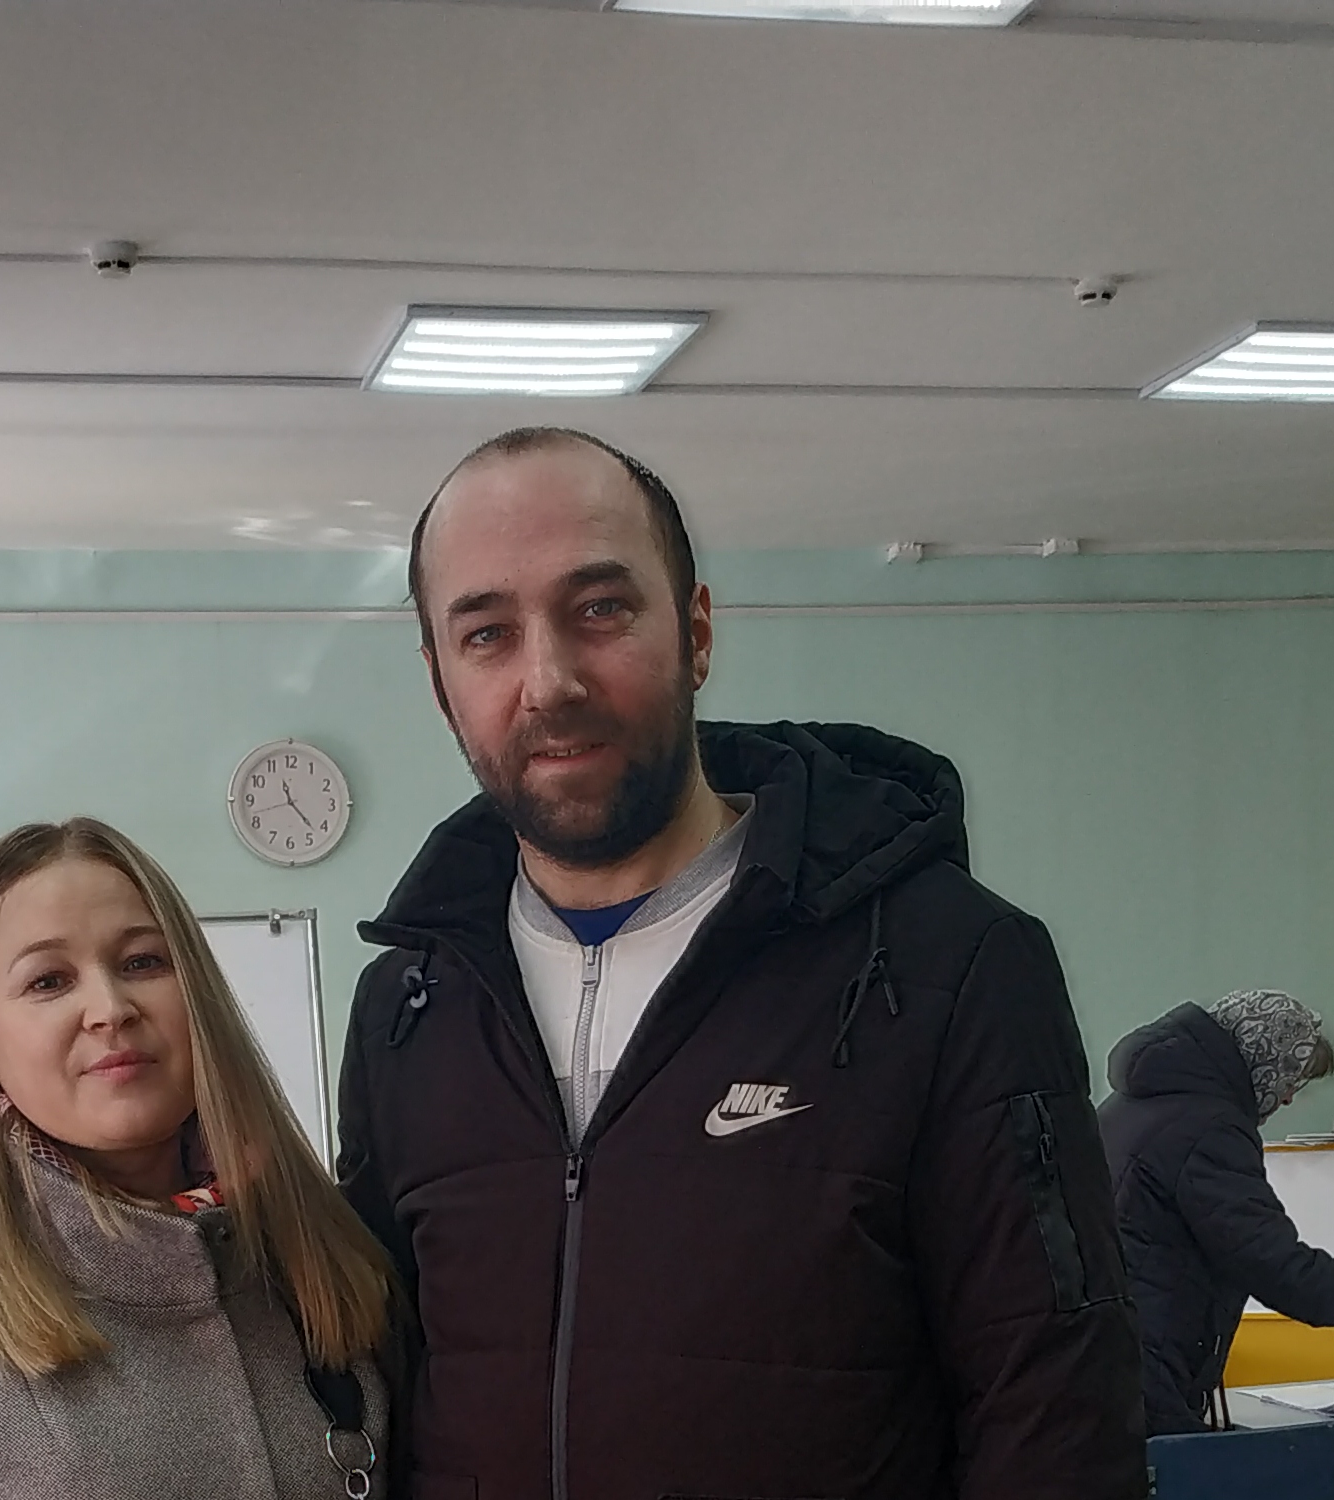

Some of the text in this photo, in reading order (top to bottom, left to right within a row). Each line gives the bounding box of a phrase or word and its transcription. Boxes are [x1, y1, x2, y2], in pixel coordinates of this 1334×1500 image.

[267, 759, 276, 773] 11
[284, 755, 298, 769] 12
[309, 762, 314, 775] 1
[252, 774, 265, 788] 10
[322, 779, 331, 792] 2
[245, 794, 255, 807] 9
[328, 798, 336, 812] 3
[251, 816, 261, 830] 8
[320, 820, 328, 832] 4
[269, 831, 277, 844] 7
[286, 836, 295, 850] 6
[305, 833, 313, 846] 5
[720, 1083, 790, 1114] NIKE
